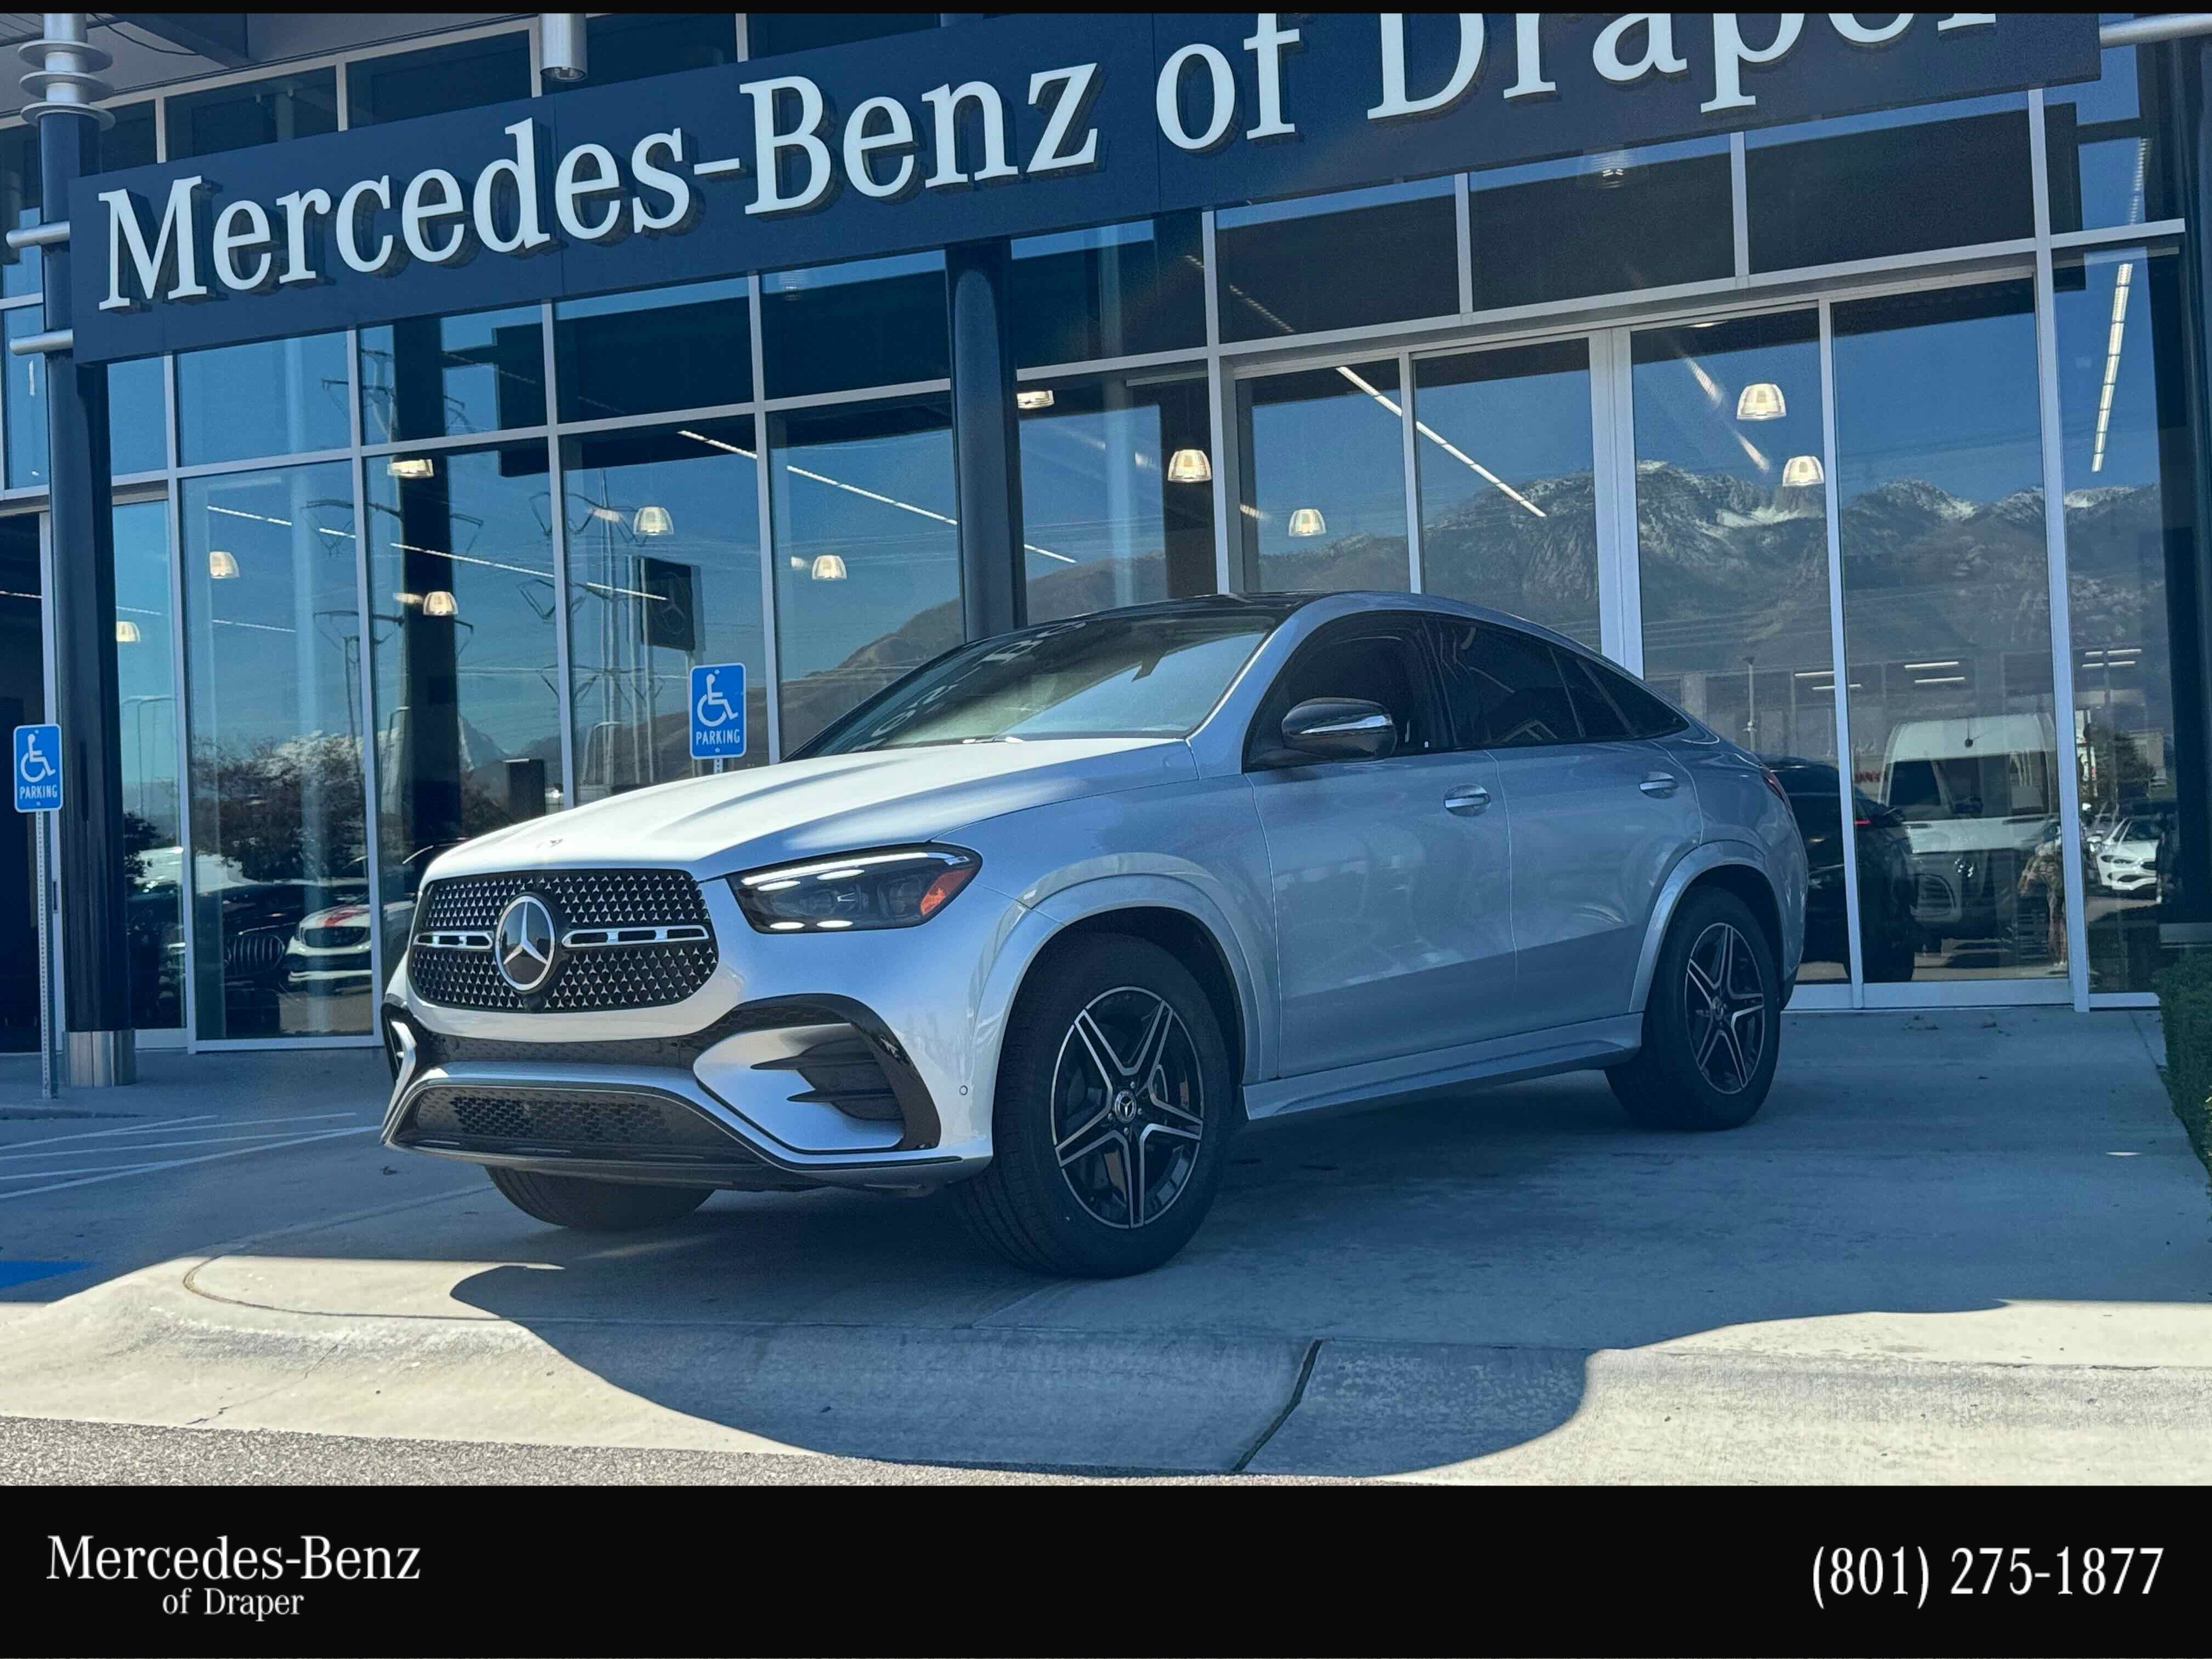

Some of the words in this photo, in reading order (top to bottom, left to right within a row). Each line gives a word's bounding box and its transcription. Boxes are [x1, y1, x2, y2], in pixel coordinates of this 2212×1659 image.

[99, 63, 1098, 309] Mercedes-Benz
[1156, 14, 1299, 149] of
[1368, 14, 1996, 119] Drap
[696, 729, 740, 745] PARKING
[20, 785, 58, 799] PARKING
